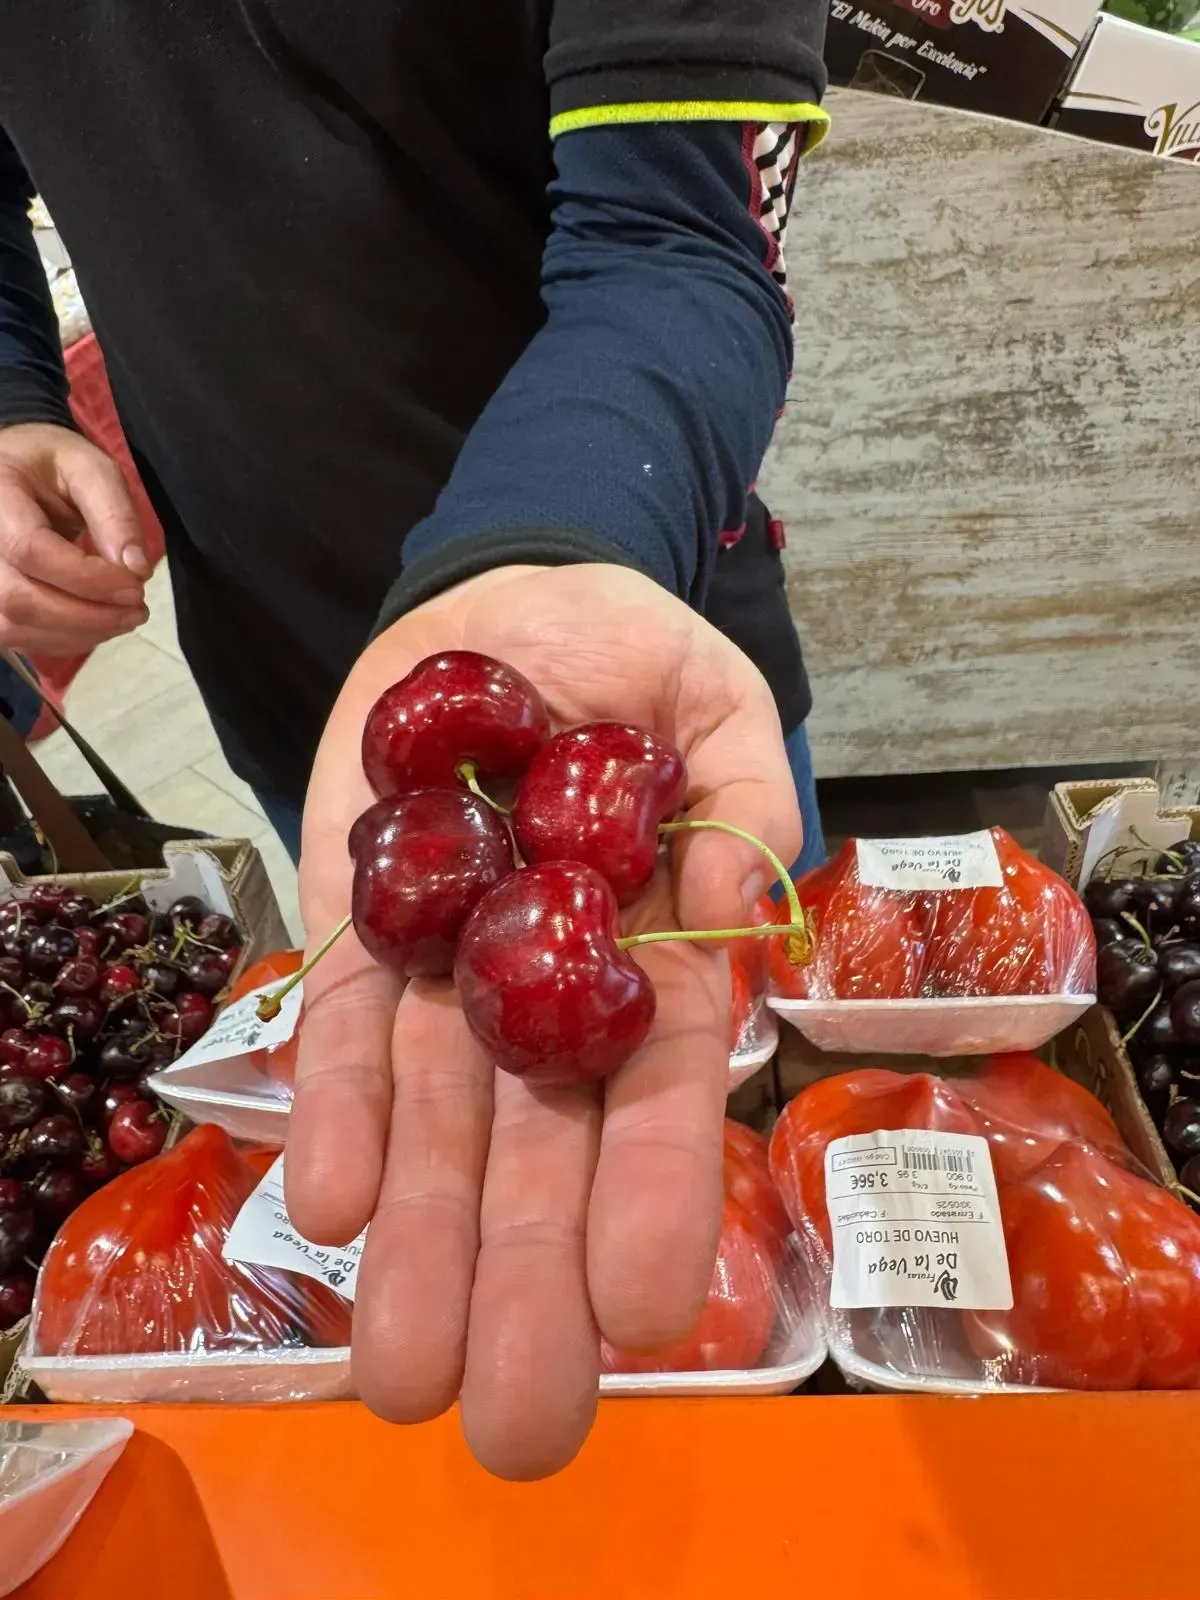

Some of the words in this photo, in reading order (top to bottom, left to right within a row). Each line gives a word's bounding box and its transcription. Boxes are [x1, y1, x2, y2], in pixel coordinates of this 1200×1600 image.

[911, 849, 925, 857] DE
[891, 859, 923, 872] Vega
[849, 1170, 889, 1190] 3,56€
[272, 1230, 310, 1255] Vega
[855, 1230, 890, 1244] TORO
[893, 1229, 911, 1242] DE
[914, 1229, 960, 1244] HUEVO
[314, 1250, 331, 1264] la
[914, 1254, 930, 1272] la
[935, 1252, 958, 1270] De
[334, 1258, 356, 1273] De
[867, 1256, 908, 1276] Vega
[907, 1273, 937, 1283] Frutas
